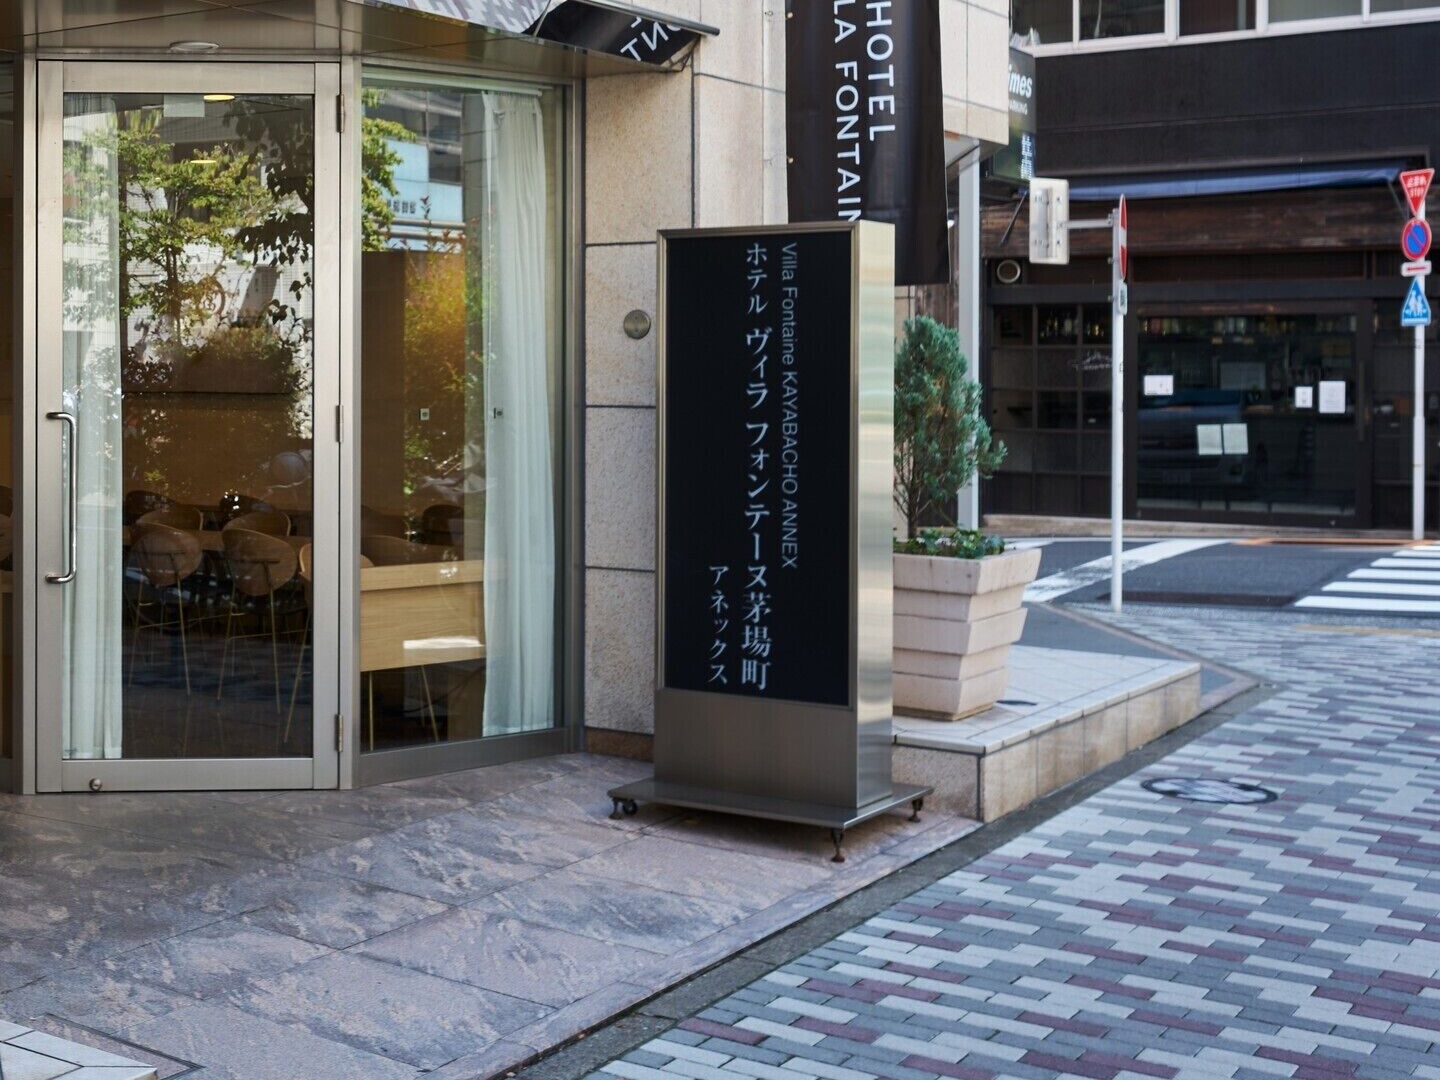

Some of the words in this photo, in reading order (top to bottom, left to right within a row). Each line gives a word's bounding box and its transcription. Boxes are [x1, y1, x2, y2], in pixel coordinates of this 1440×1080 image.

[865, 0, 896, 142] HOTEL
[1009, 64, 1032, 98] imes
[835, 60, 862, 222] FONTAIN
[746, 243, 769, 314] ホテル
[781, 242, 798, 281] Villa
[781, 287, 799, 365] Fontaine
[781, 371, 799, 495] KAYABACHO
[781, 499, 799, 569] ANNEX
[708, 565, 730, 684] アネックス
